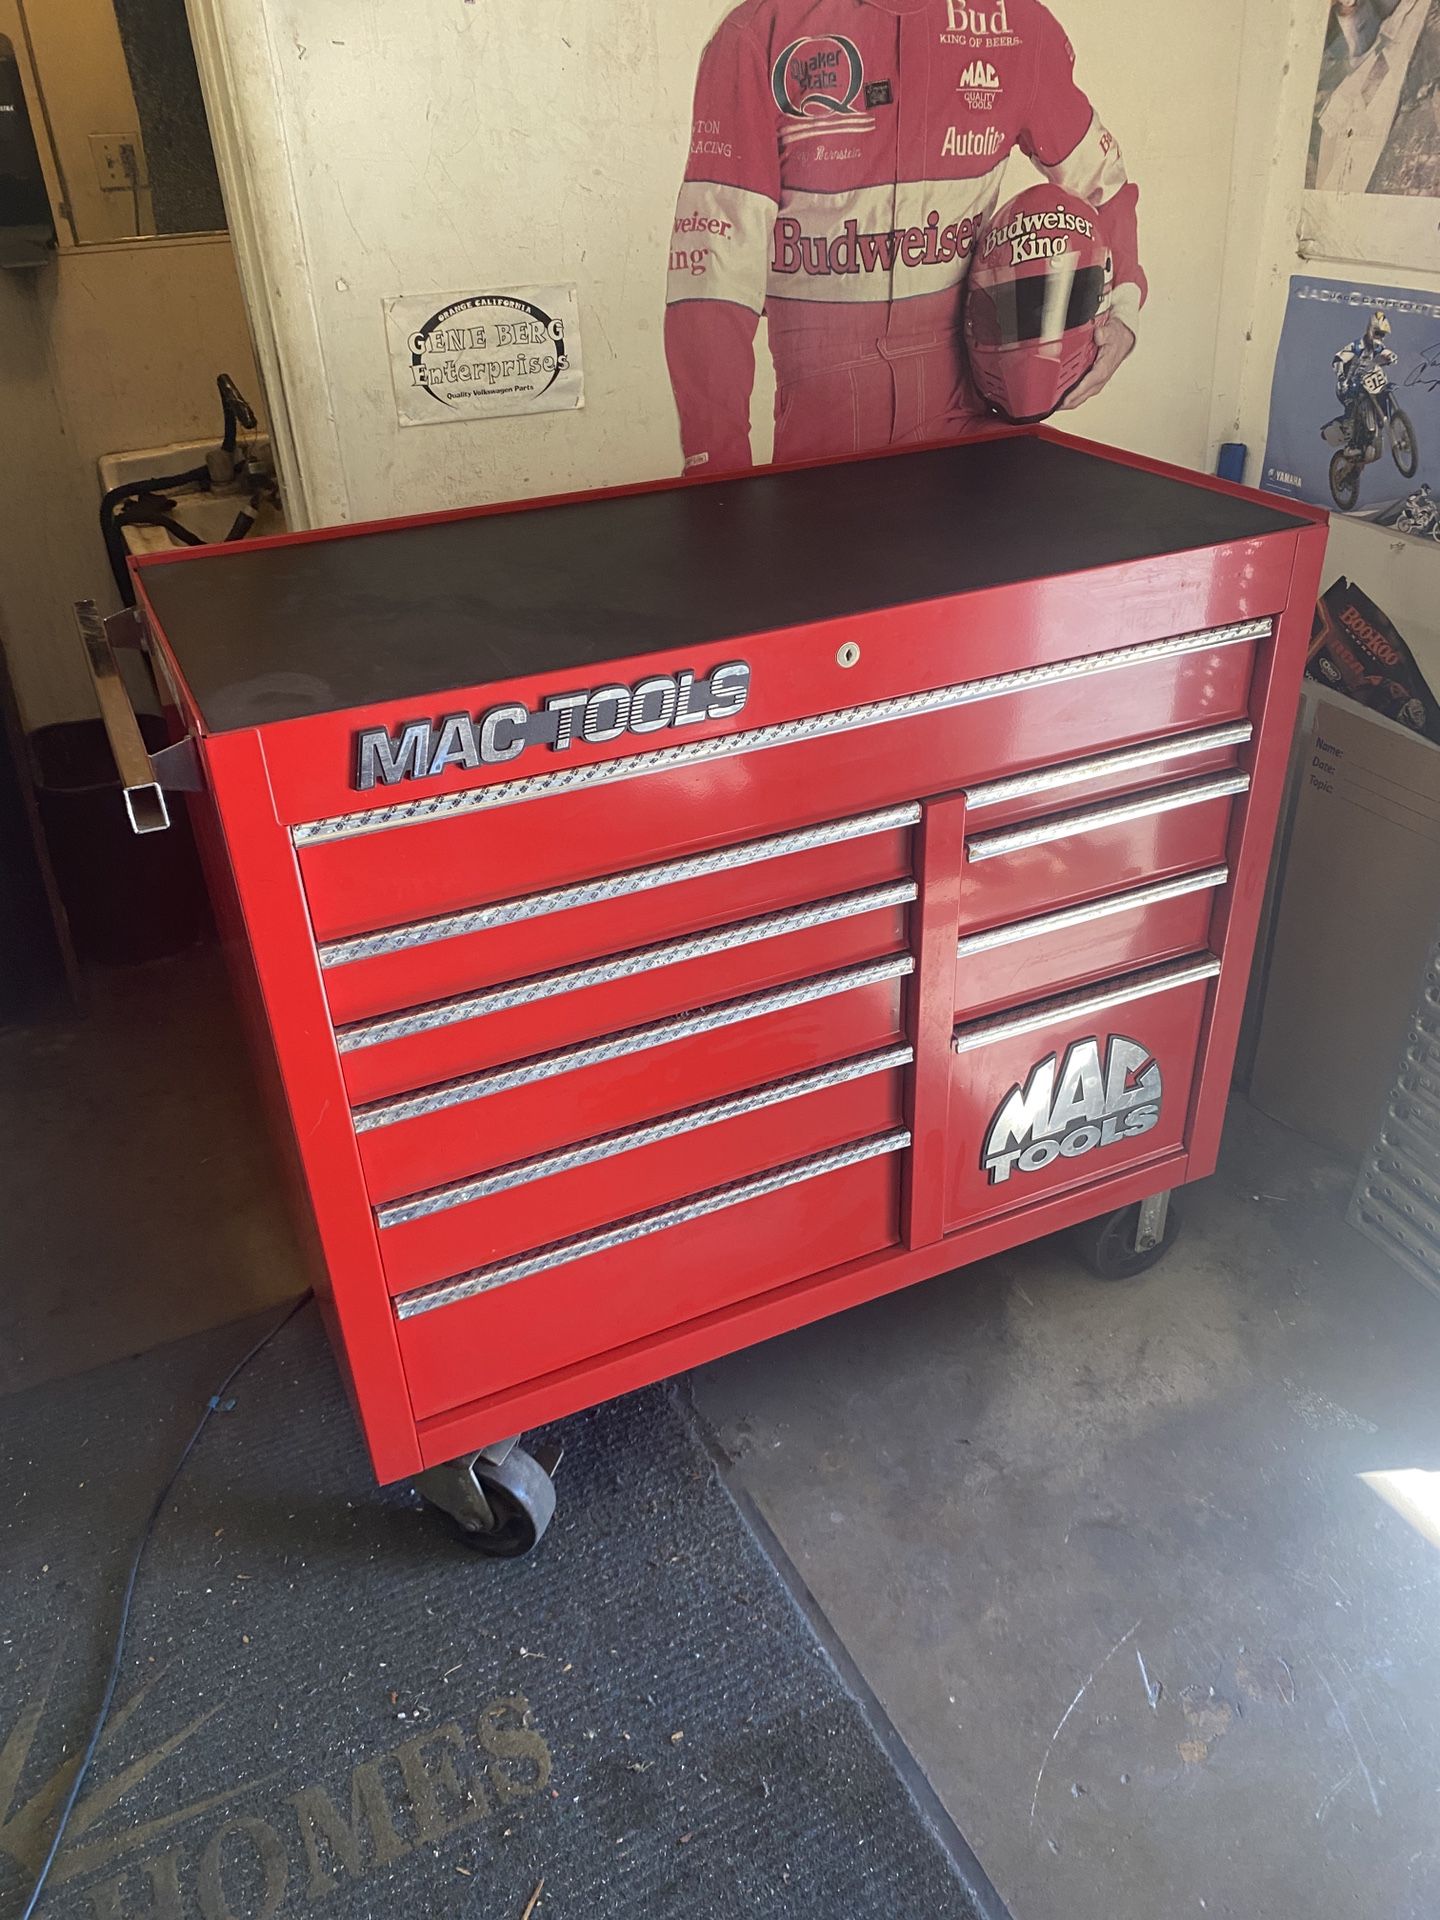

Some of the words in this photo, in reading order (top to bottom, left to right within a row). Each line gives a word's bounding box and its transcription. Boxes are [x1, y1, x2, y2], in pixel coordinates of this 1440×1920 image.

[946, 0, 1014, 34] Bud
[939, 34, 967, 45] KING
[969, 36, 983, 48] OF
[789, 49, 842, 82] Quaker
[959, 60, 1000, 88] MAC
[964, 92, 996, 103] QUALITY
[968, 100, 993, 110] TOOLS
[771, 209, 982, 276] Budweiser
[1010, 235, 1069, 266] King
[438, 301, 472, 322] ORANGE
[474, 298, 531, 314] CALIFORNIA
[407, 326, 486, 354] GENE
[494, 318, 565, 347] BERG
[410, 353, 570, 387] Enterprises
[446, 391, 472, 400] Quality
[473, 386, 513, 396] Volkswagen
[514, 384, 534, 392] Parts
[1275, 470, 1302, 488] YAMAHA
[355, 700, 527, 792] MAC
[545, 659, 752, 752] TOOLS
[1315, 737, 1344, 759] Name:
[1312, 756, 1336, 775] Date:
[982, 1034, 1162, 1158] MAC
[985, 1103, 1160, 1185] TOOLS
